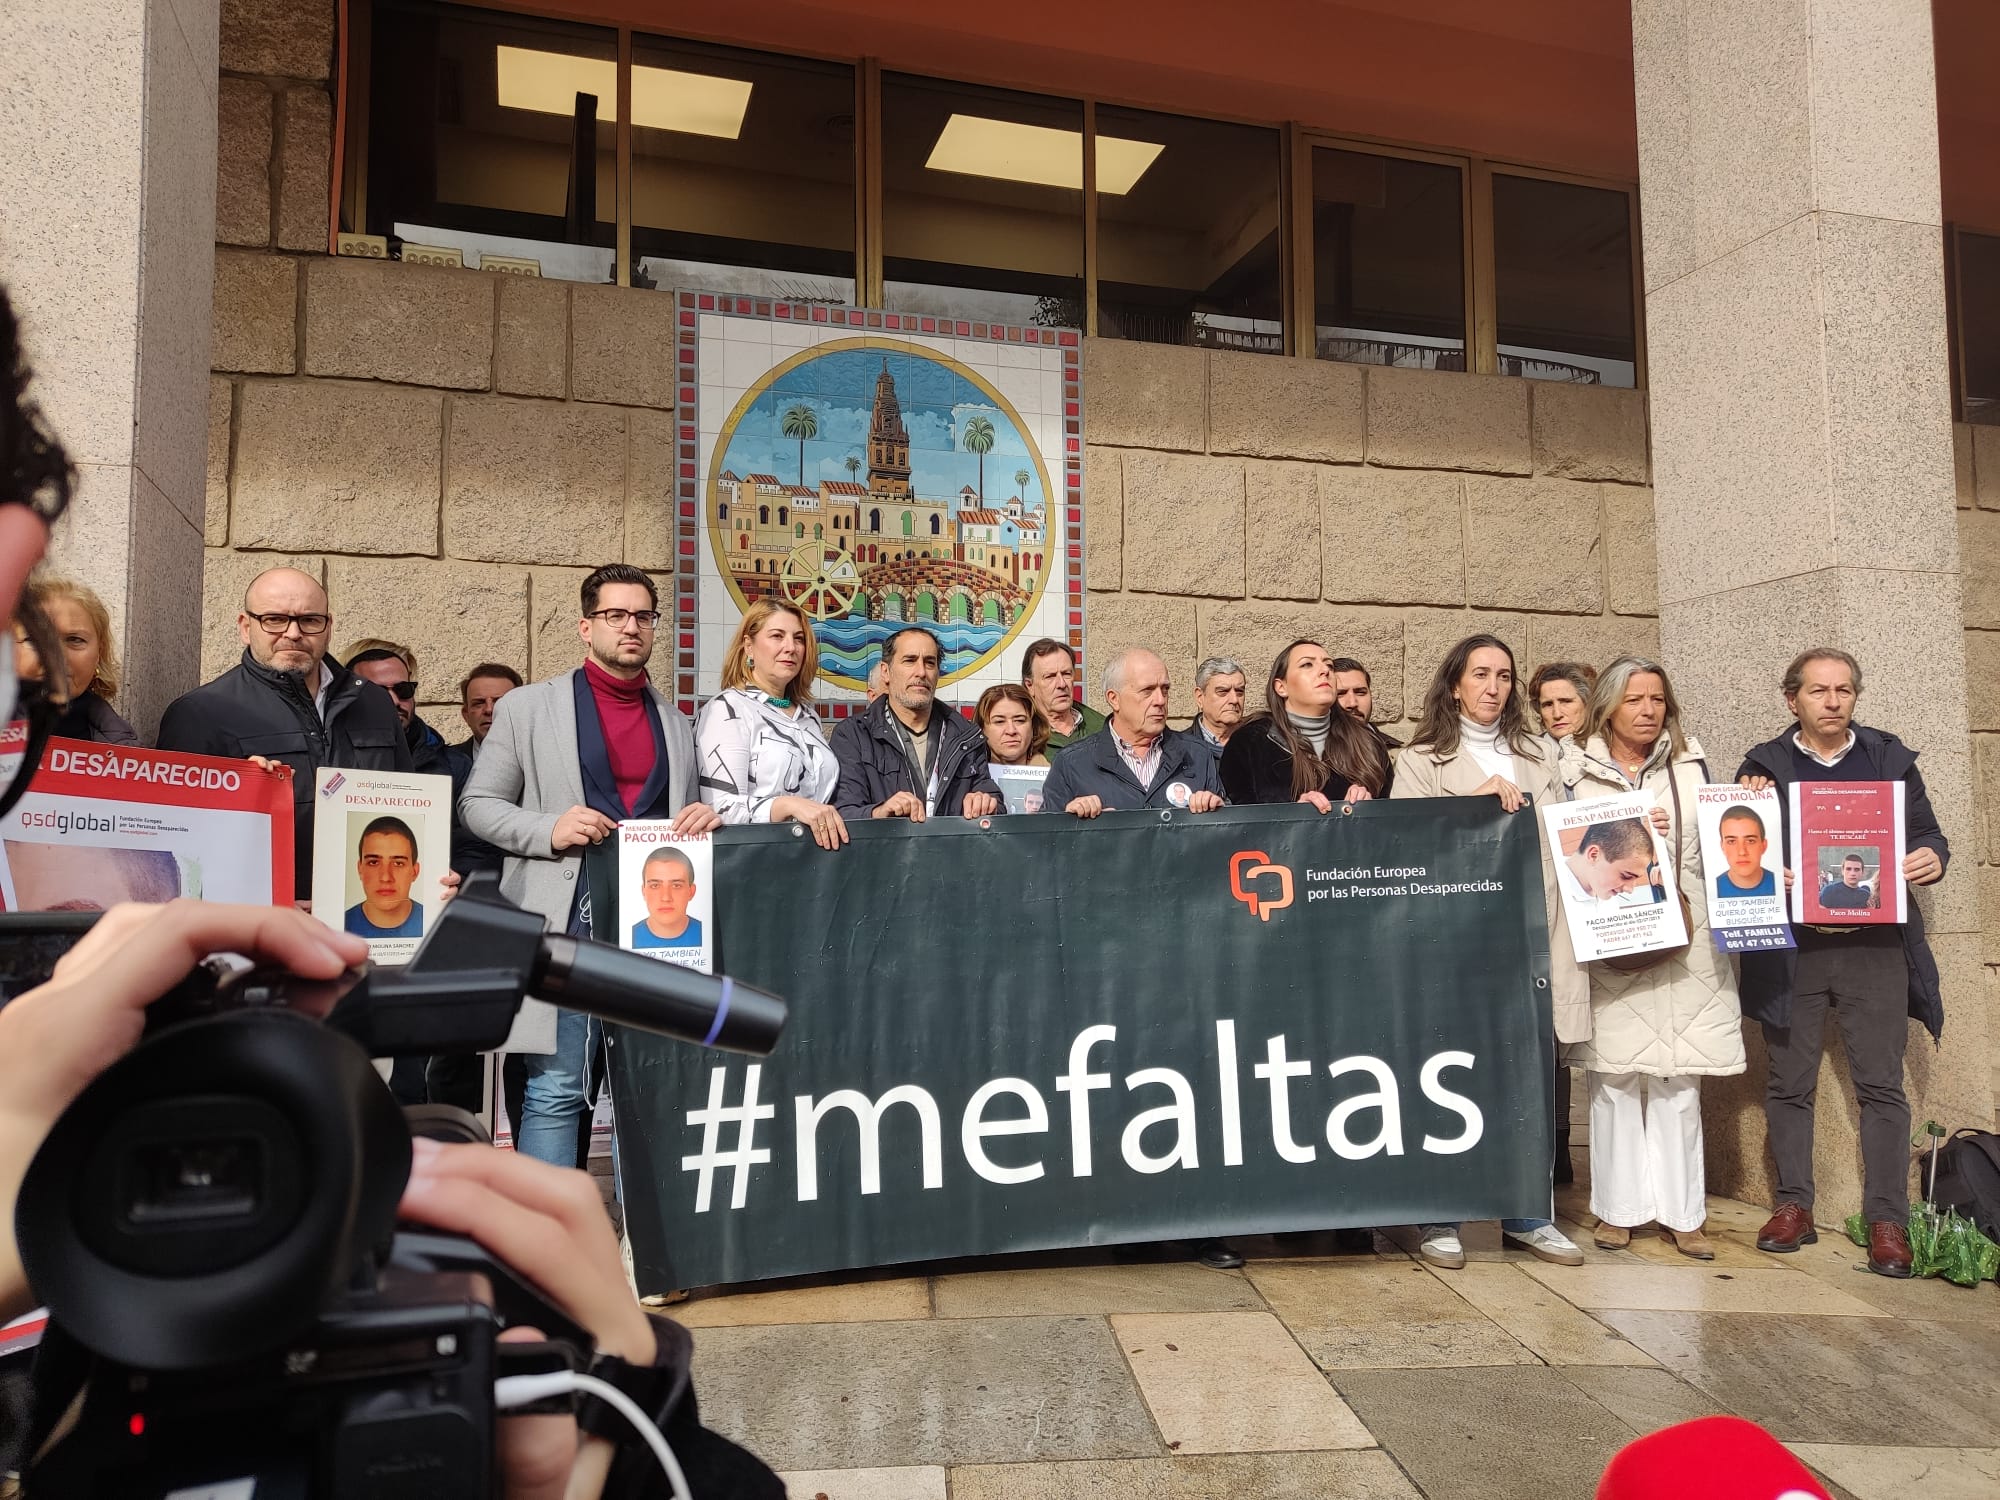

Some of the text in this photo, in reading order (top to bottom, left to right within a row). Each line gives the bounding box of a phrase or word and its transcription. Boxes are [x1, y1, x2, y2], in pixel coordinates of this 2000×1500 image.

[50, 749, 241, 792] DESAPARECIDO
[1002, 768, 1049, 777] DESAPARECID
[345, 794, 432, 808] DESAPARECIDO
[1698, 791, 1774, 803] PACO MOLINA
[1563, 805, 1644, 826] DESAPARECIDO
[624, 832, 709, 843] PACO MOLINA
[1306, 866, 1426, 881] Fundación Europea
[1308, 879, 1503, 902] por las Personas Desaparecidas
[1716, 909, 1747, 917] QUIERO
[1749, 907, 1766, 916] QUE
[1586, 918, 1606, 926] PACO
[1607, 913, 1633, 923] MOLINA
[1721, 927, 1784, 938] Telf. FAMILIA
[1746, 939, 1758, 947] 47
[1760, 938, 1773, 946] 19
[692, 959, 707, 967] ME
[680, 1019, 1486, 1215] #mefaltas
